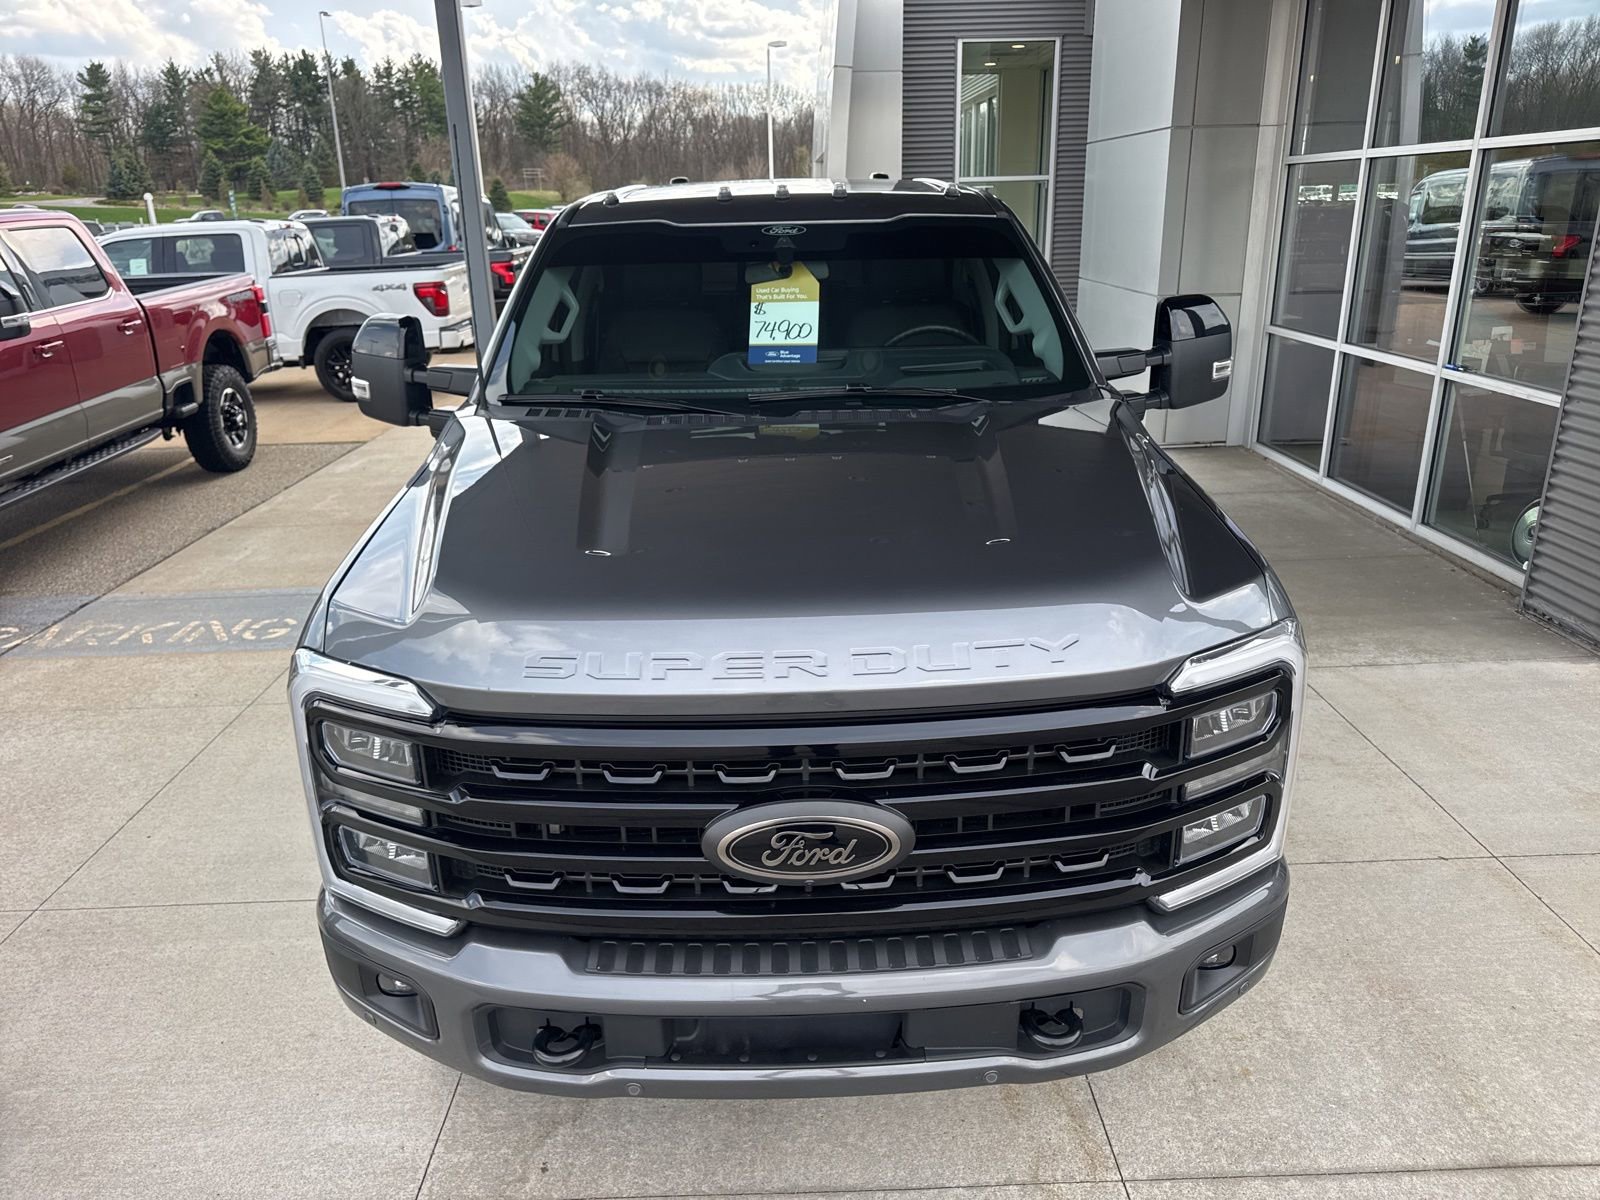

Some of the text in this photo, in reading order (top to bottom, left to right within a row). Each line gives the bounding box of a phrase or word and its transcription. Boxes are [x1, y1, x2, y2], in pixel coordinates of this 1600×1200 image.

[781, 286, 800, 294] Buying
[522, 633, 1080, 681] SUPER DUTY
[761, 829, 859, 868] Ford
